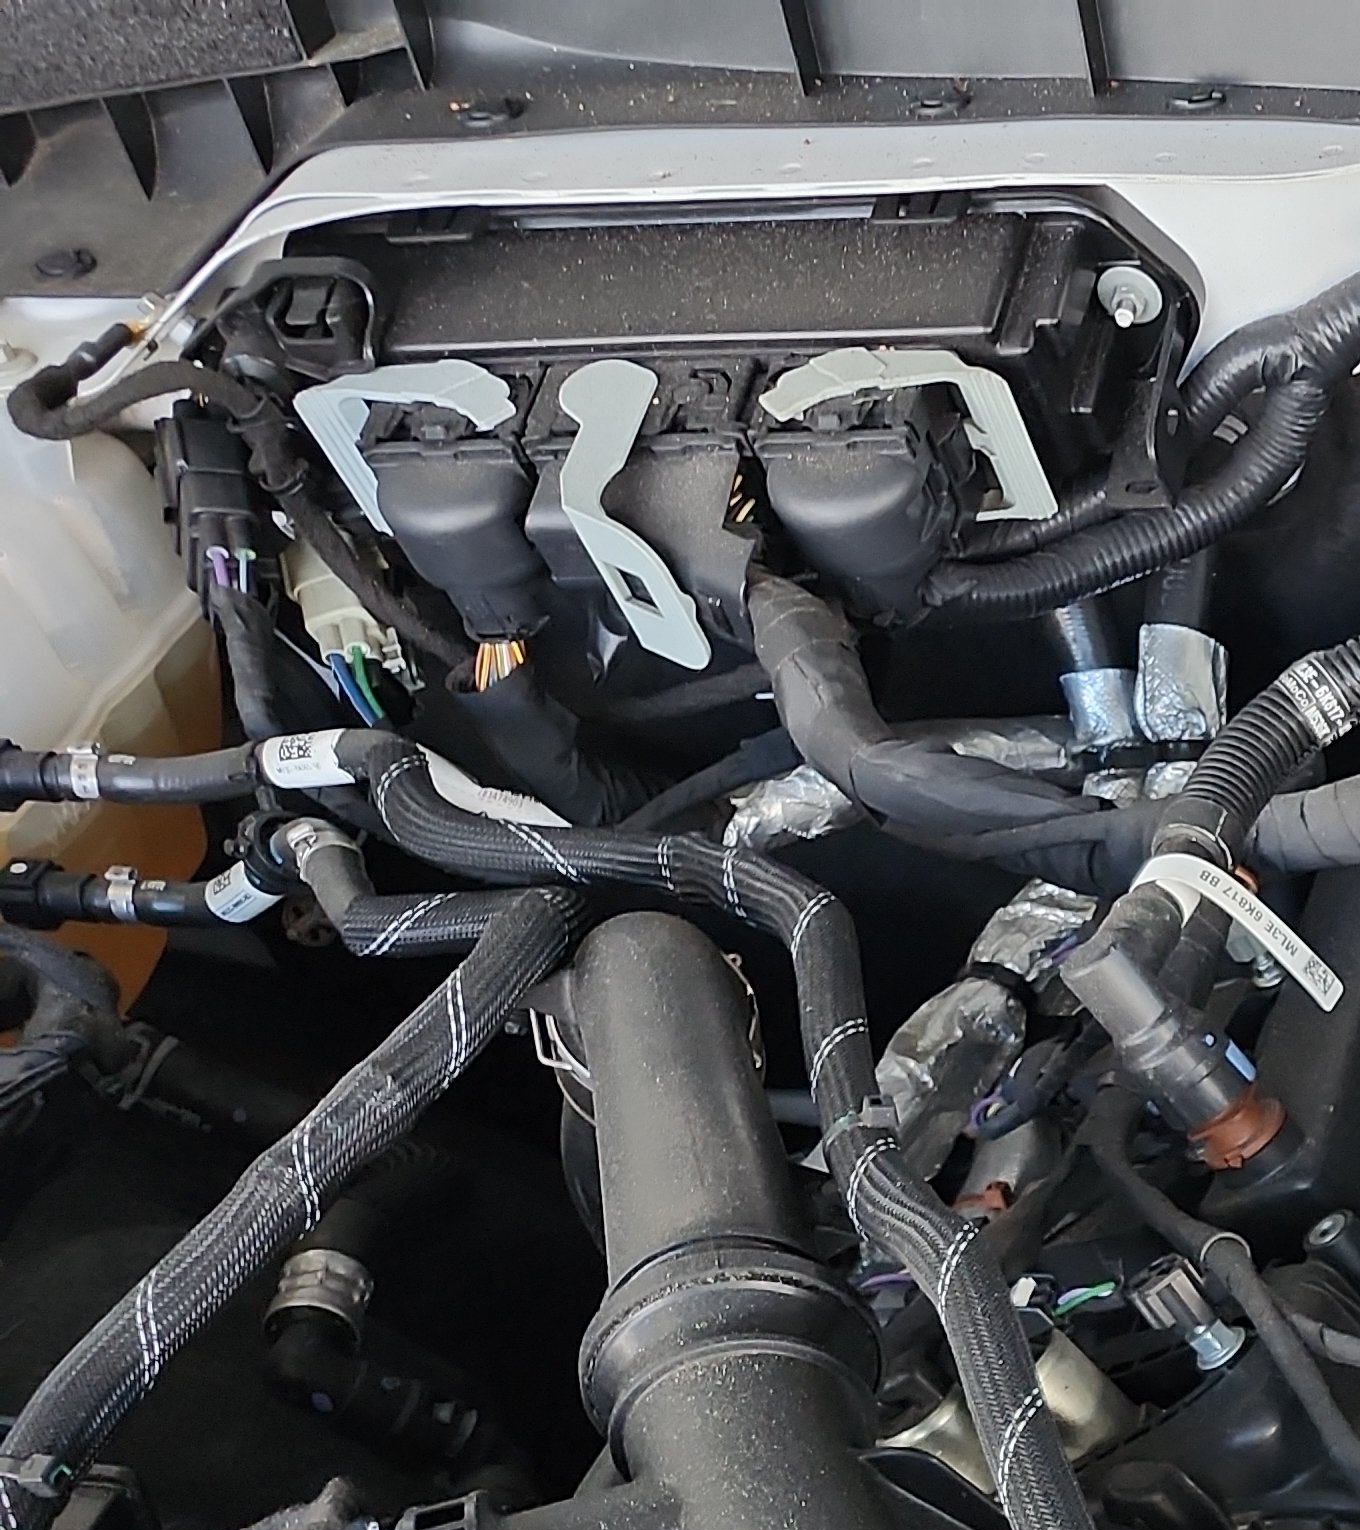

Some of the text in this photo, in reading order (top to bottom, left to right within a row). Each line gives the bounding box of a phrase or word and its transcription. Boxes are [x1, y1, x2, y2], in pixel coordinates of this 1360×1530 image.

[1199, 870, 1299, 957] ML3E 6K817 BB
